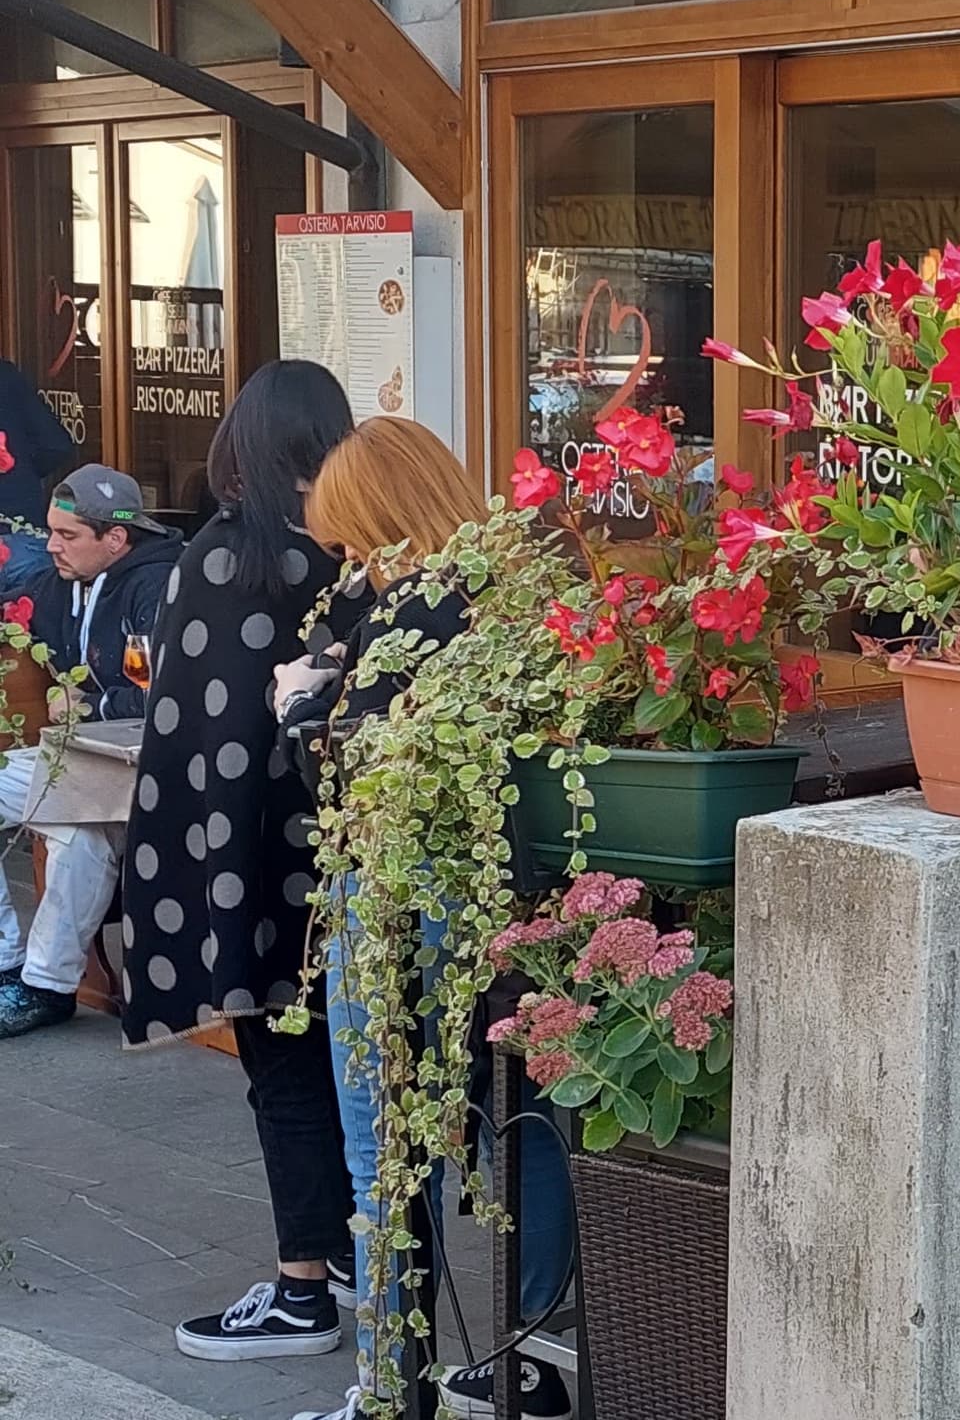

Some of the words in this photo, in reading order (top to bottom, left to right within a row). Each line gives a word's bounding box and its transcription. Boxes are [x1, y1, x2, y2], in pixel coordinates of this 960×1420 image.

[298, 215, 339, 233] OSTERIA
[340, 213, 386, 233] TARVISIO
[135, 346, 161, 372] BAR
[165, 347, 220, 375] PIZZERIA
[137, 385, 221, 418] RISTORANTE
